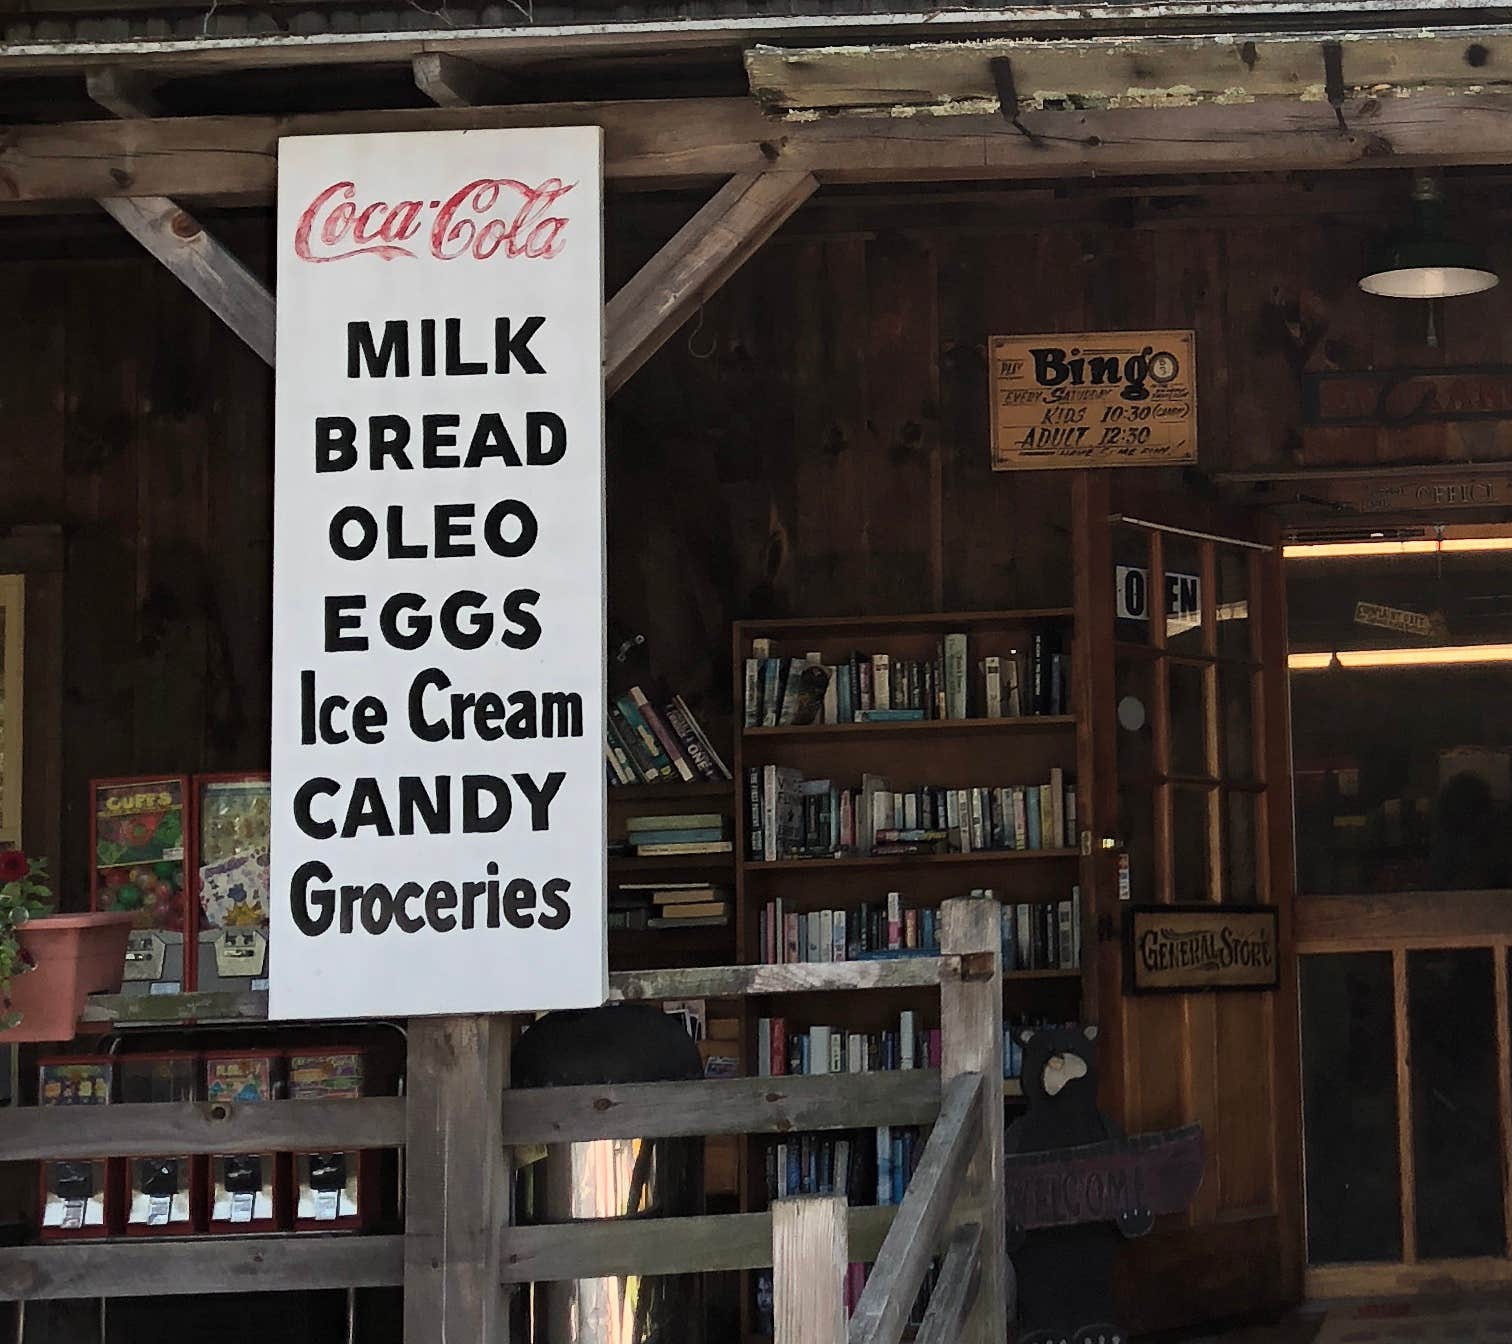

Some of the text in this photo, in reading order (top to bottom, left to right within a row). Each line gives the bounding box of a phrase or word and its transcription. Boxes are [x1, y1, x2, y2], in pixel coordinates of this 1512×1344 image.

[294, 178, 580, 264] Coca-Cola
[348, 317, 546, 378] MILK
[1028, 346, 1180, 402] Bingo
[316, 412, 566, 473] BREAD
[1015, 426, 1152, 449] ADULT 12:30
[1040, 405, 1088, 426] KIDS
[1100, 404, 1152, 423] 10:30
[329, 499, 538, 560] OLEO
[325, 589, 541, 652] EGGS
[1125, 569, 1198, 616] OEN
[301, 670, 387, 745] Ice
[409, 668, 583, 742] Cream
[294, 772, 566, 839] CANDY
[290, 861, 571, 936] Groceries
[1139, 926, 1273, 972] GENERAL STORE
